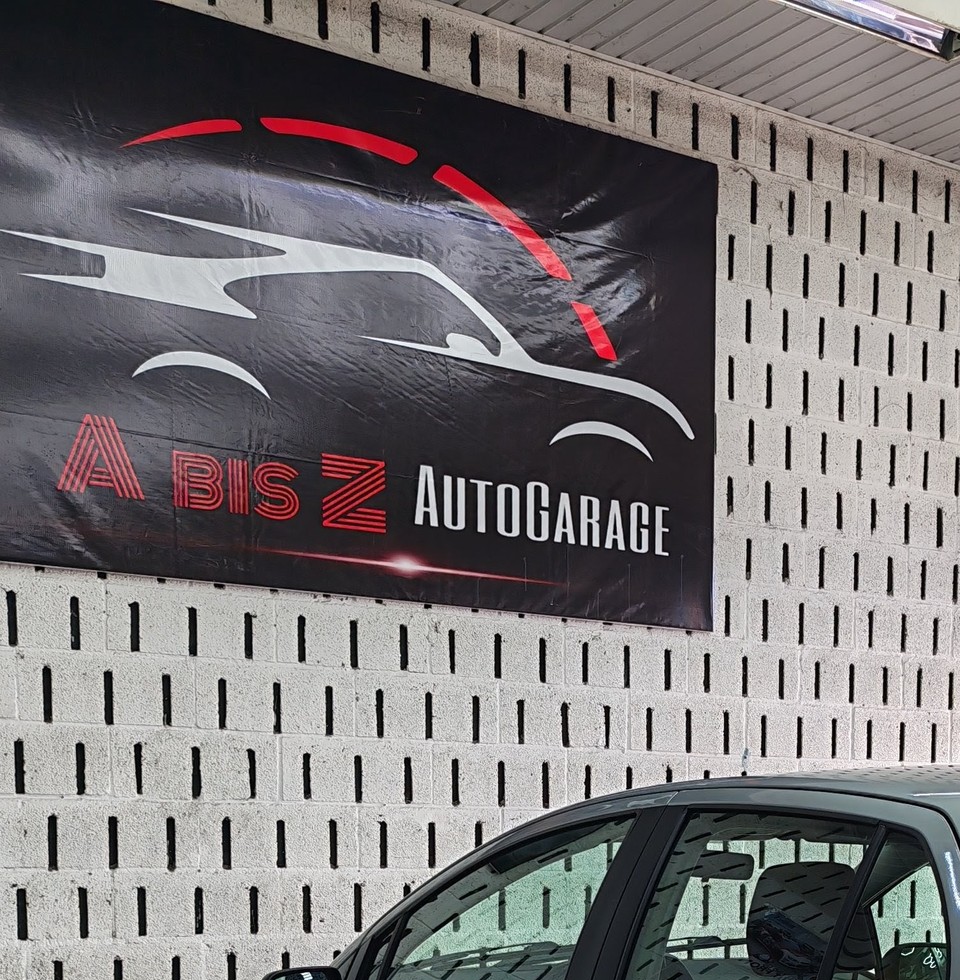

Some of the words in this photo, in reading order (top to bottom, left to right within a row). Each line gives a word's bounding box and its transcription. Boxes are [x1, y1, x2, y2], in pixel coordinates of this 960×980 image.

[56, 413, 145, 500] A
[172, 449, 299, 521] BIS
[320, 452, 387, 534] Z
